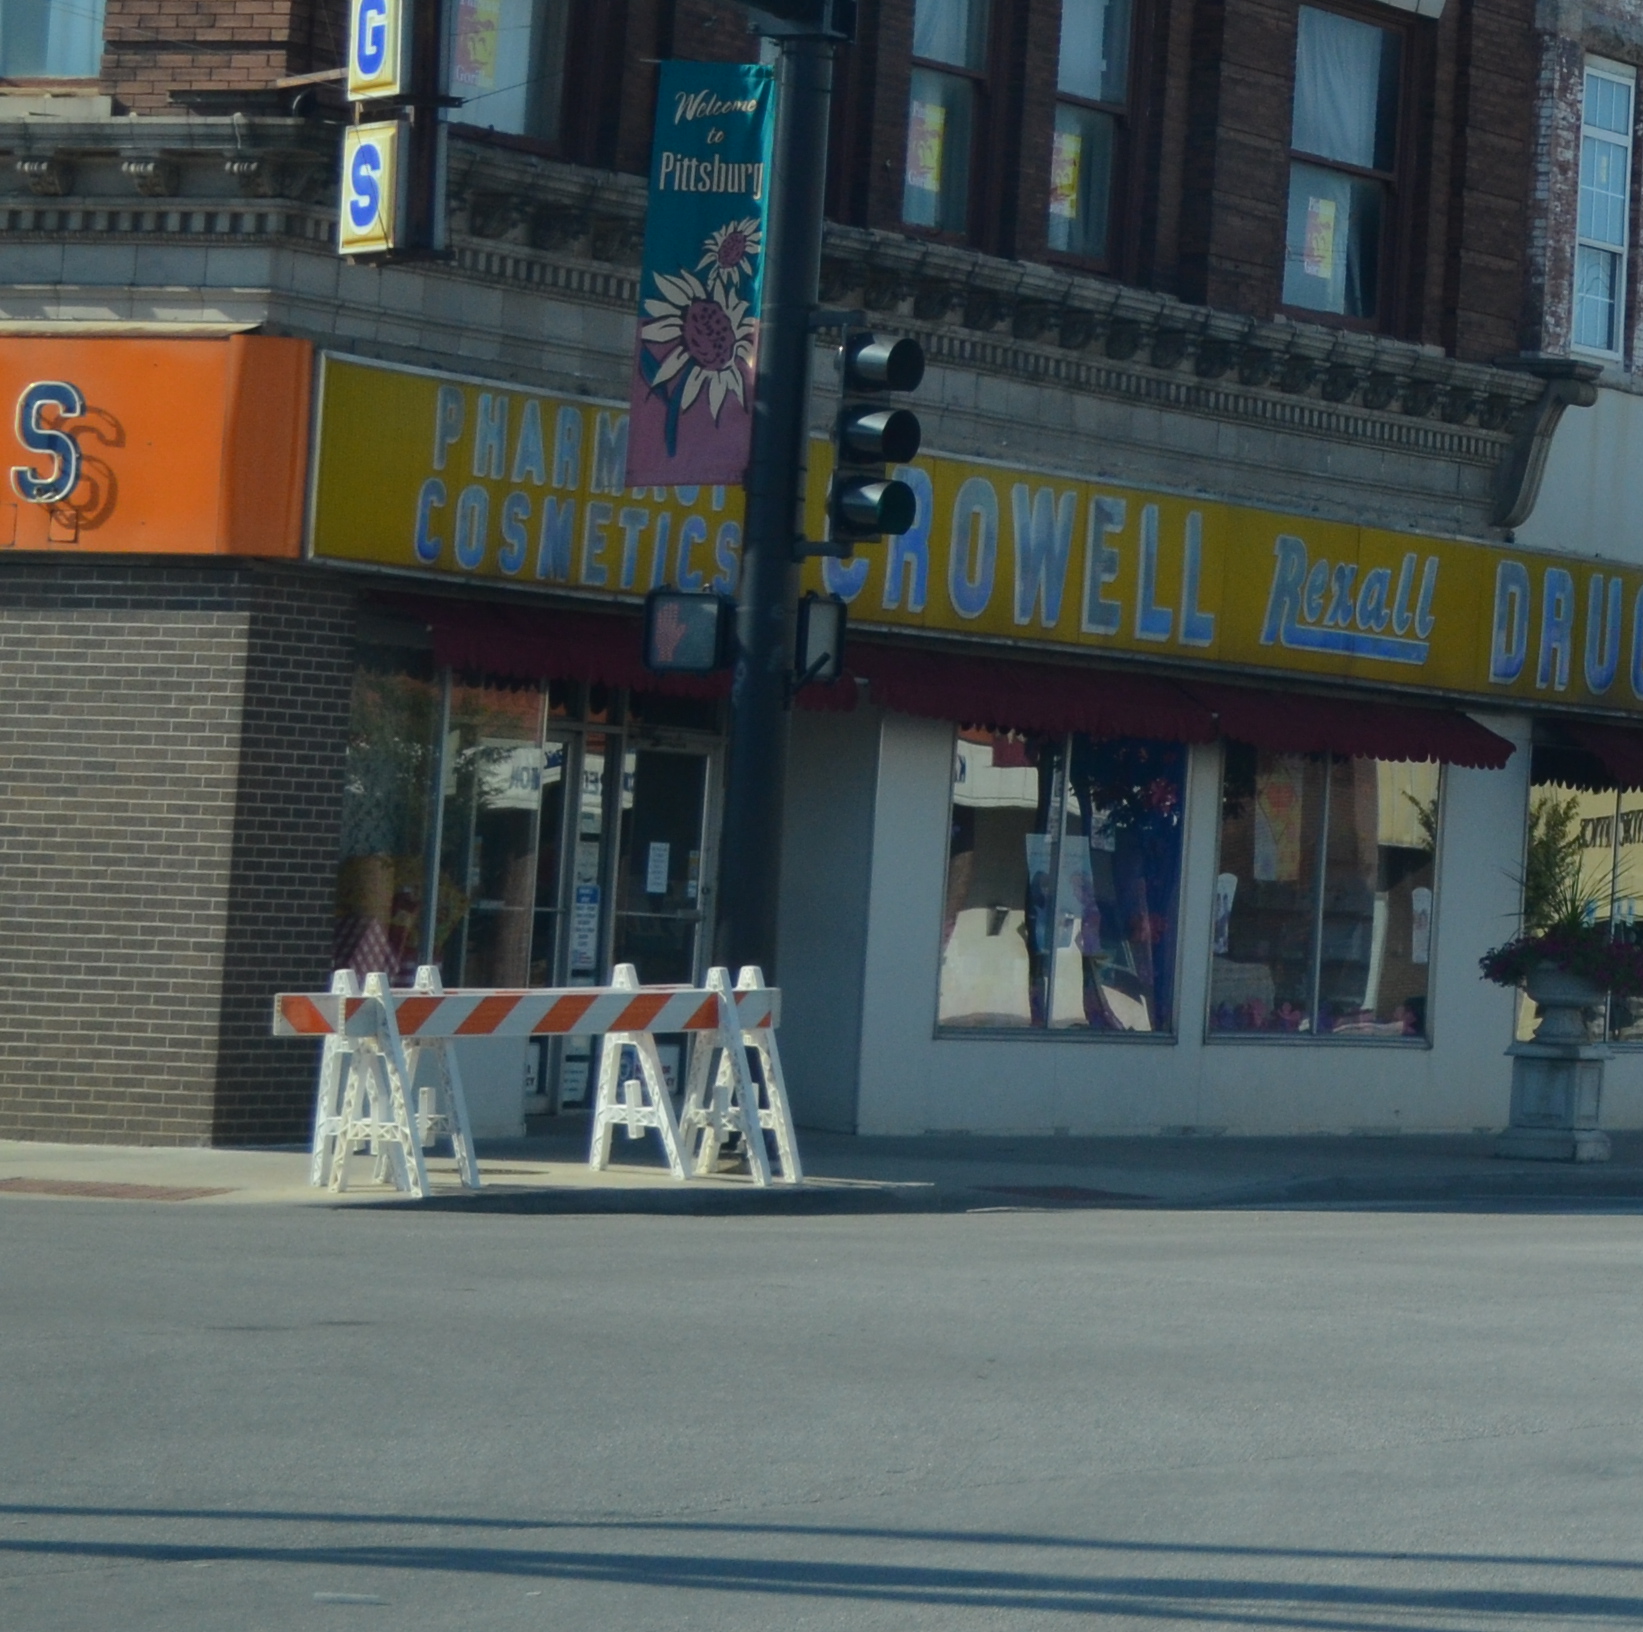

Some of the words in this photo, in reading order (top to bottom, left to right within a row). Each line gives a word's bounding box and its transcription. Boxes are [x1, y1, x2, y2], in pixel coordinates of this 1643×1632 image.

[674, 89, 758, 125] Welcome
[706, 127, 725, 144] to
[658, 151, 764, 200] Pittsburg
[433, 384, 727, 511] PHARM
[413, 476, 743, 596] COSMETICS
[1260, 533, 1440, 665] Rexall
